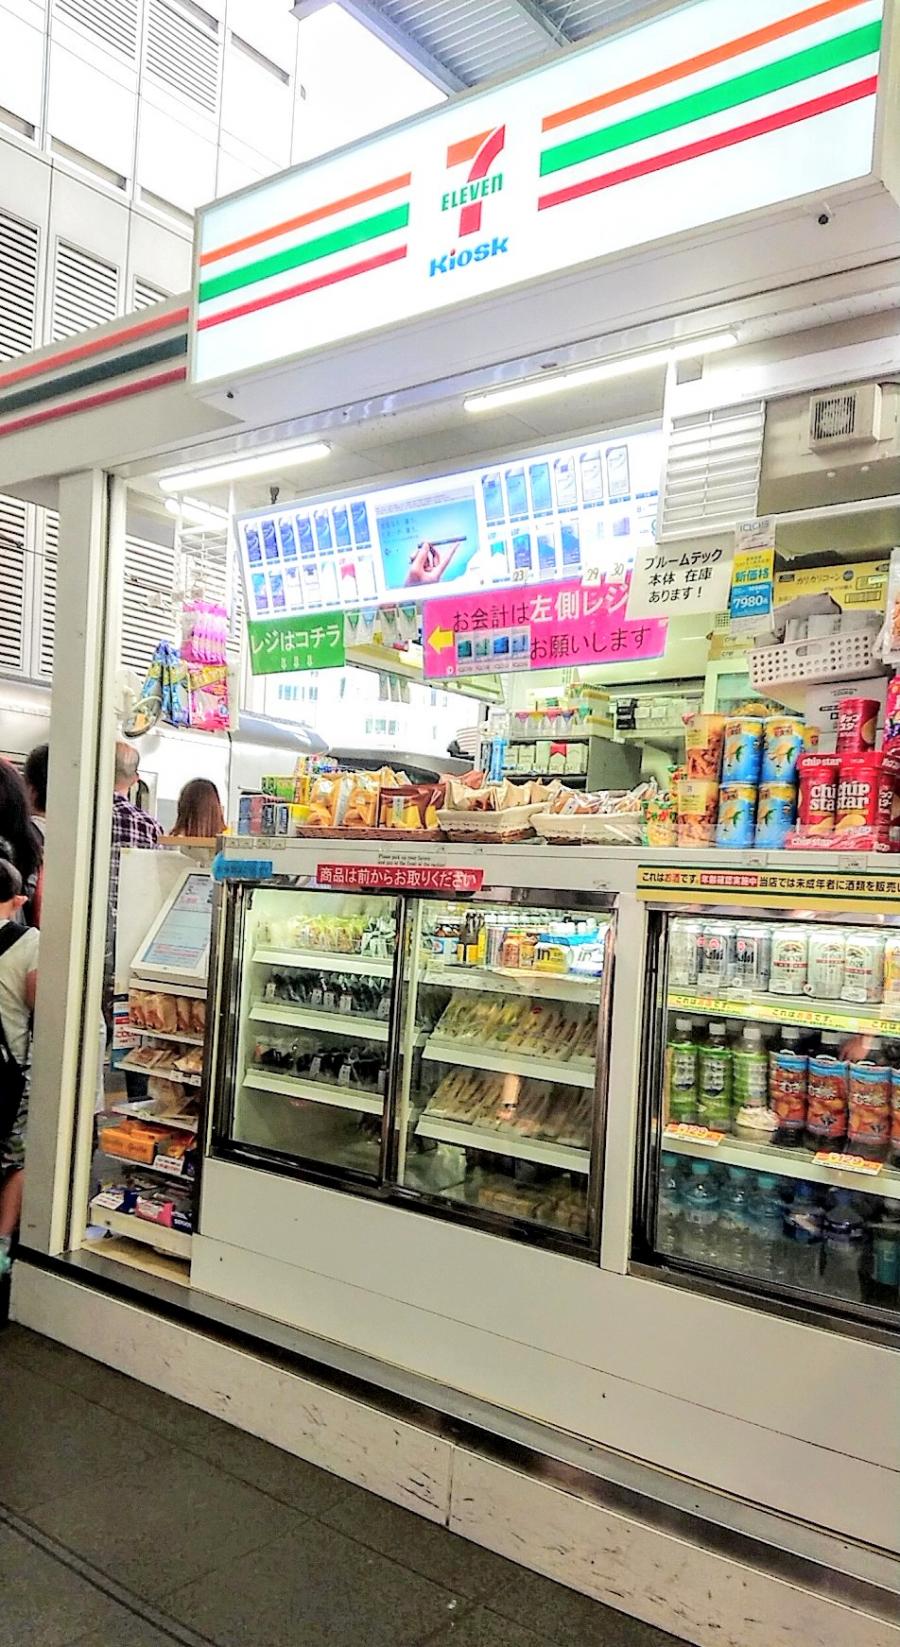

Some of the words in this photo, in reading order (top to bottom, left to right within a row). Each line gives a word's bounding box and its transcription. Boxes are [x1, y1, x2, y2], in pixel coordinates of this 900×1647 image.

[648, 572, 676, 587] 本体
[685, 567, 712, 582] 在庫
[250, 624, 341, 654] レジはコチラ
[530, 625, 651, 660] お願いします
[811, 784, 836, 799] chi
[809, 798, 835, 811] sta
[319, 866, 477, 888] 商品は前からお取りください
